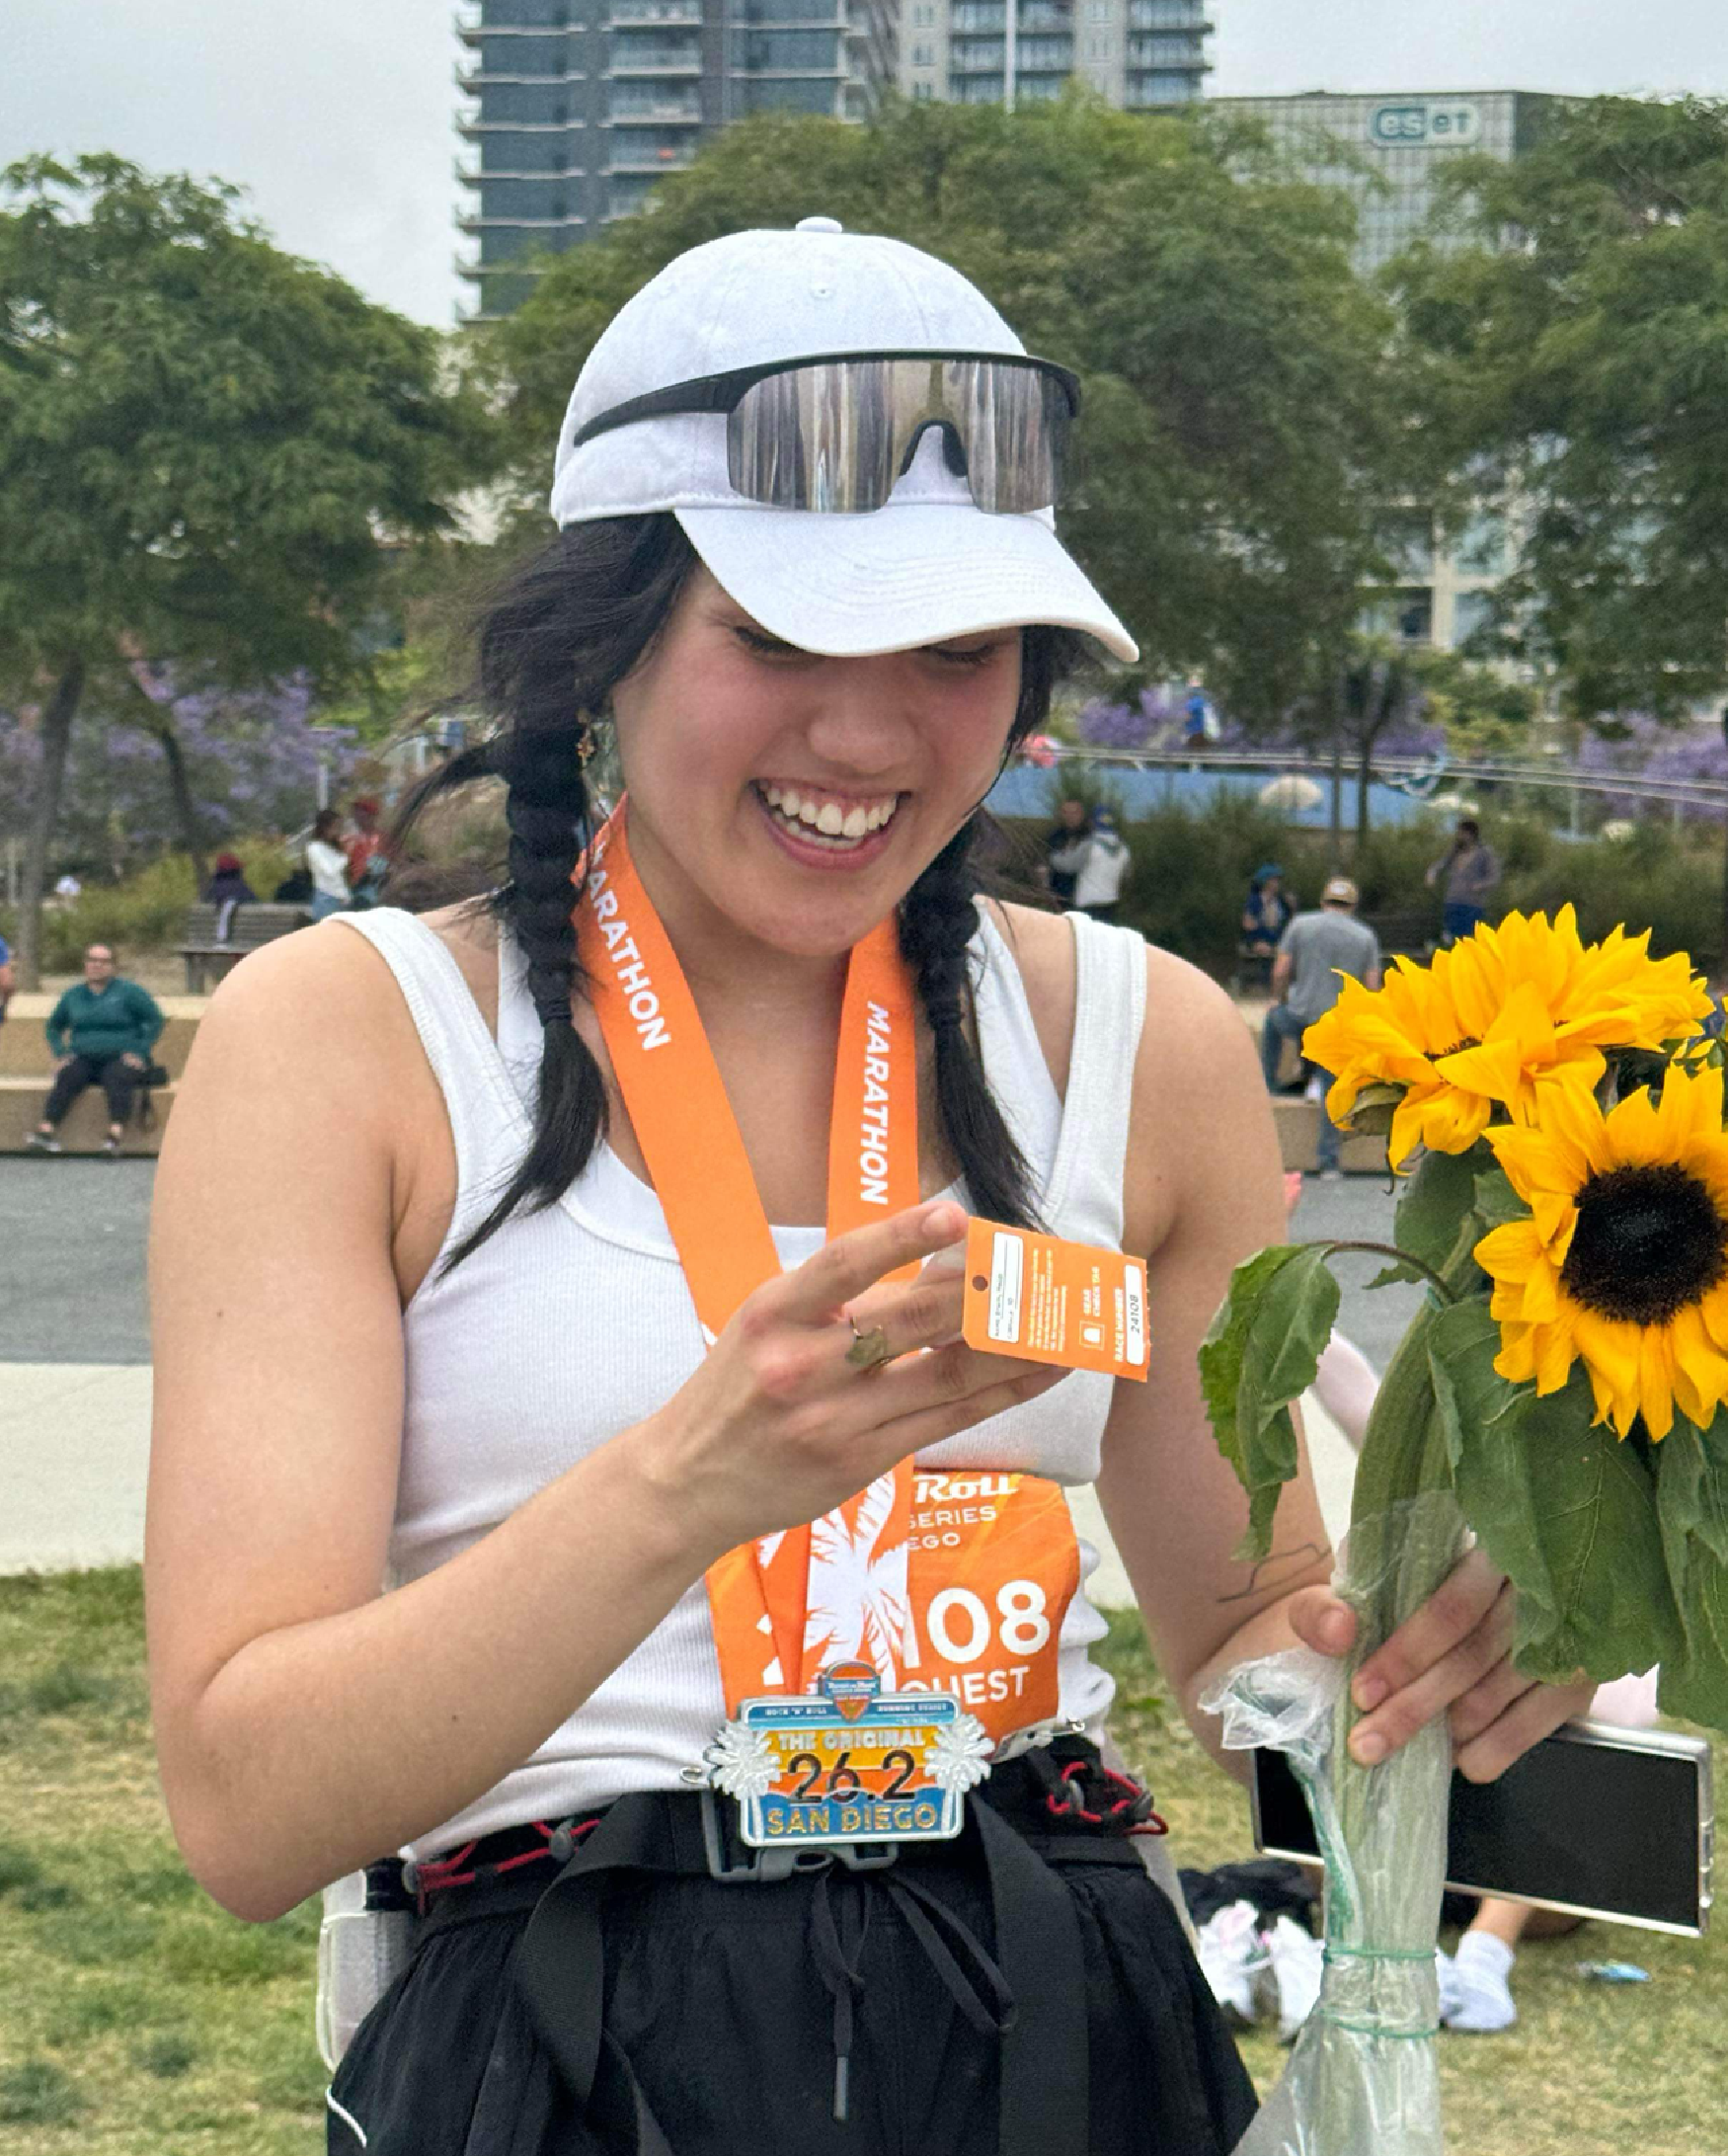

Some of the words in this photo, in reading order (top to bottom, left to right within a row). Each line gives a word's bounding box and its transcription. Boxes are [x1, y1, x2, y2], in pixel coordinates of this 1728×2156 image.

[859, 1000, 893, 1205] MARATHON
[907, 1532, 961, 1552] EGO
[903, 1579, 1051, 1670] 108
[779, 1733, 816, 1750] THE
[824, 1730, 925, 1750] ORIGINAL
[787, 1750, 916, 1803] 26.2
[767, 1807, 830, 1835] SAN
[840, 1803, 938, 1832] DIEGO
